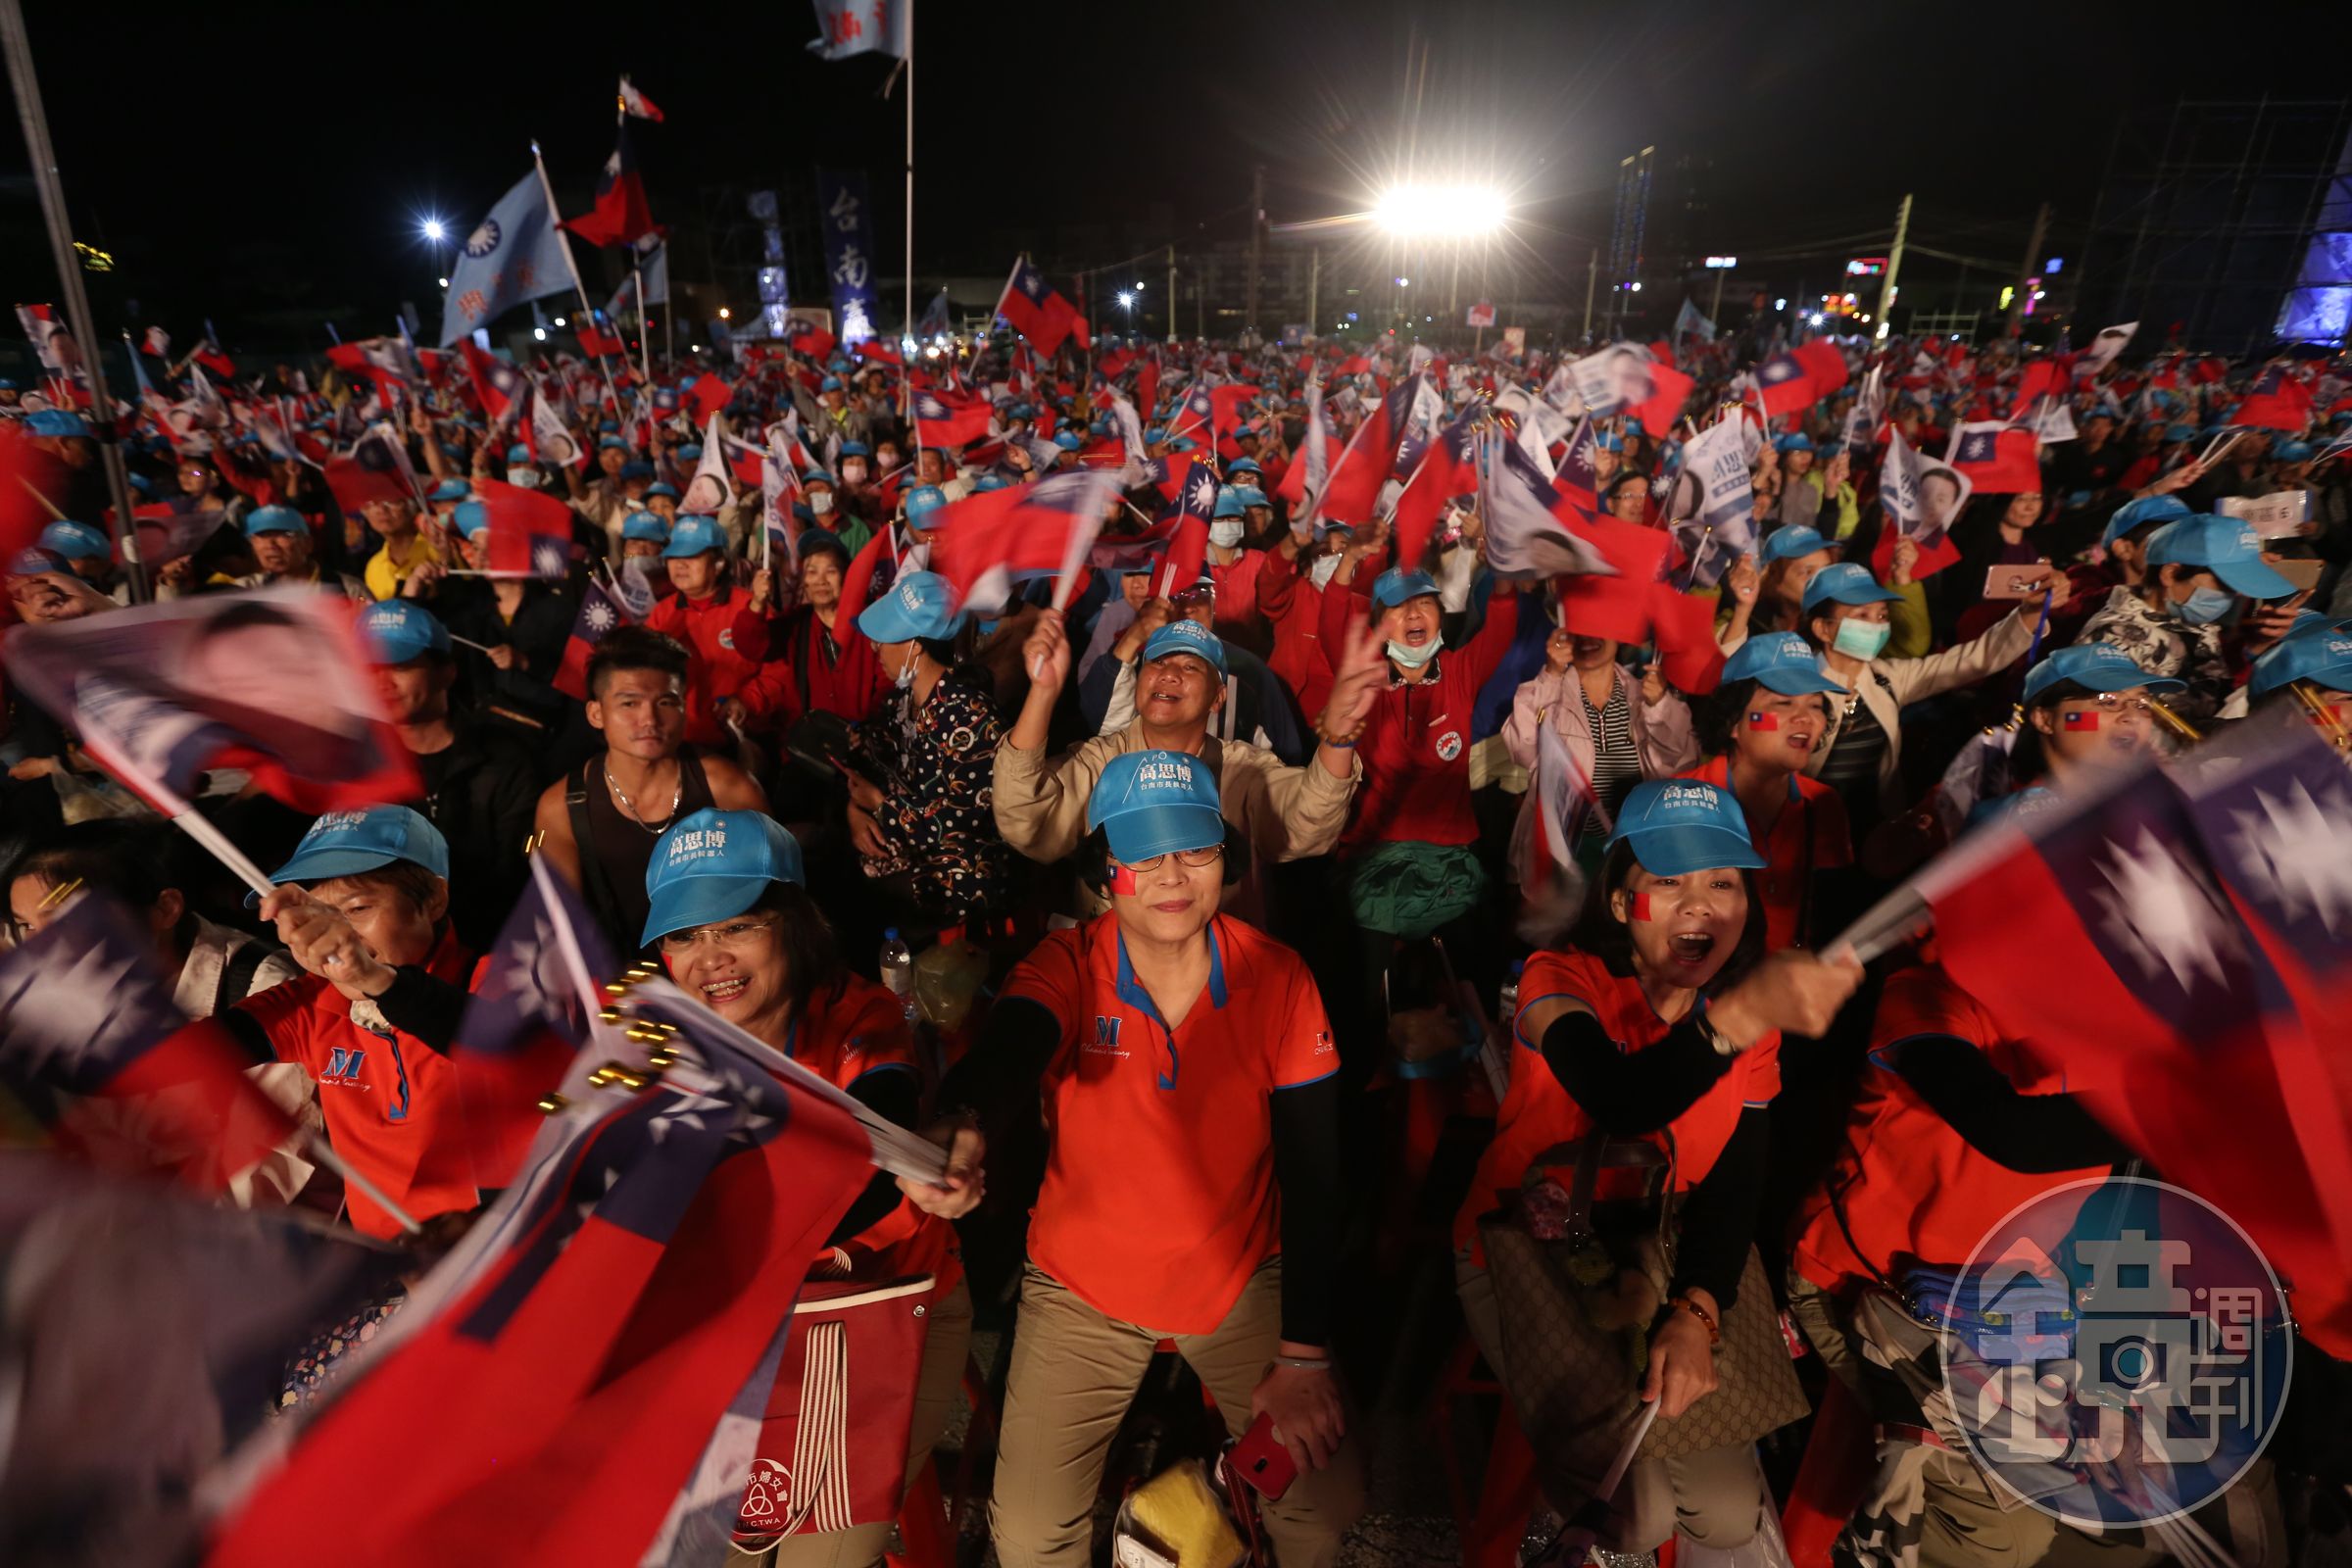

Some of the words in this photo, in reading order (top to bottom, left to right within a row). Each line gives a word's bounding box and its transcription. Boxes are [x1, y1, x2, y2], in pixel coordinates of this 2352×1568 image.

[1140, 762, 1193, 783] 高思博
[669, 829, 726, 858] 高思博
[1095, 1015, 1123, 1047] M
[321, 1046, 368, 1080] M
